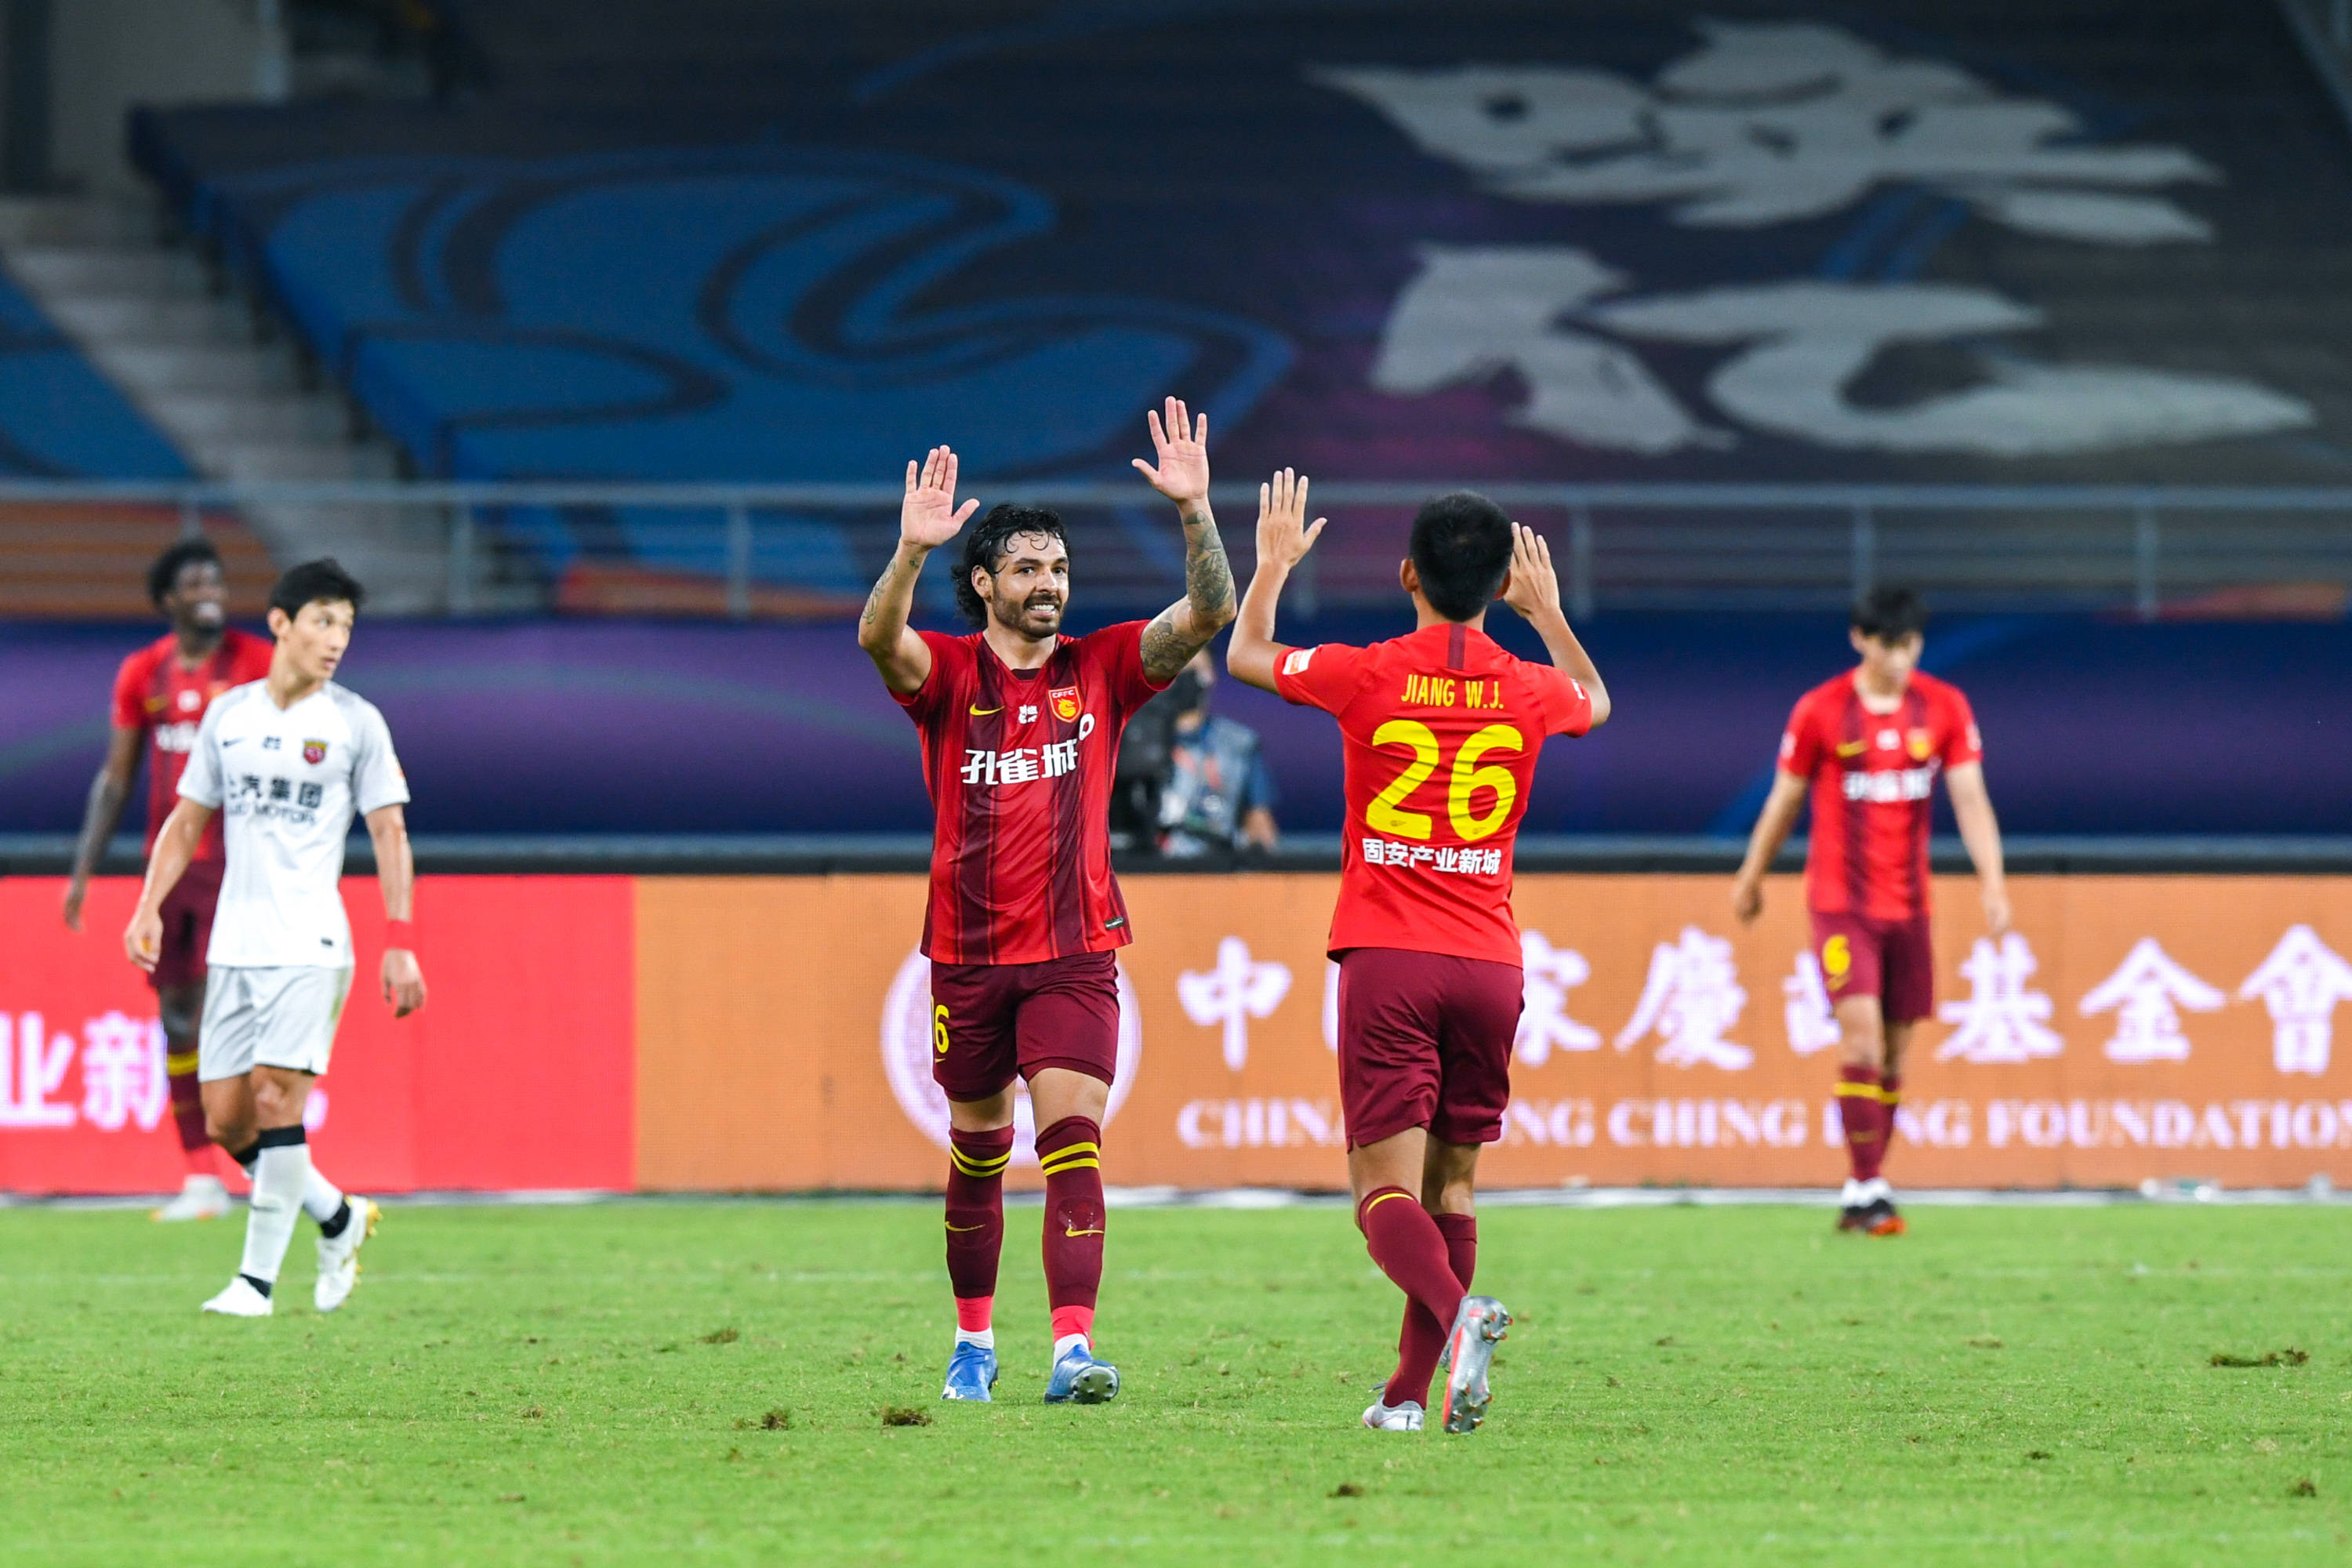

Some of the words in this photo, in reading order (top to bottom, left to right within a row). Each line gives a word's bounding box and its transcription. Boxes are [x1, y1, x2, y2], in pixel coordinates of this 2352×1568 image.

[1401, 674, 1455, 707] JIANG
[1465, 681, 1504, 709] W.J.
[1366, 719, 1523, 841] 26
[1362, 838, 1502, 875] 固安产业新城
[931, 994, 950, 1054] 6
[1177, 1098, 1344, 1149] CHIN
[1607, 1098, 1808, 1148] CHING
